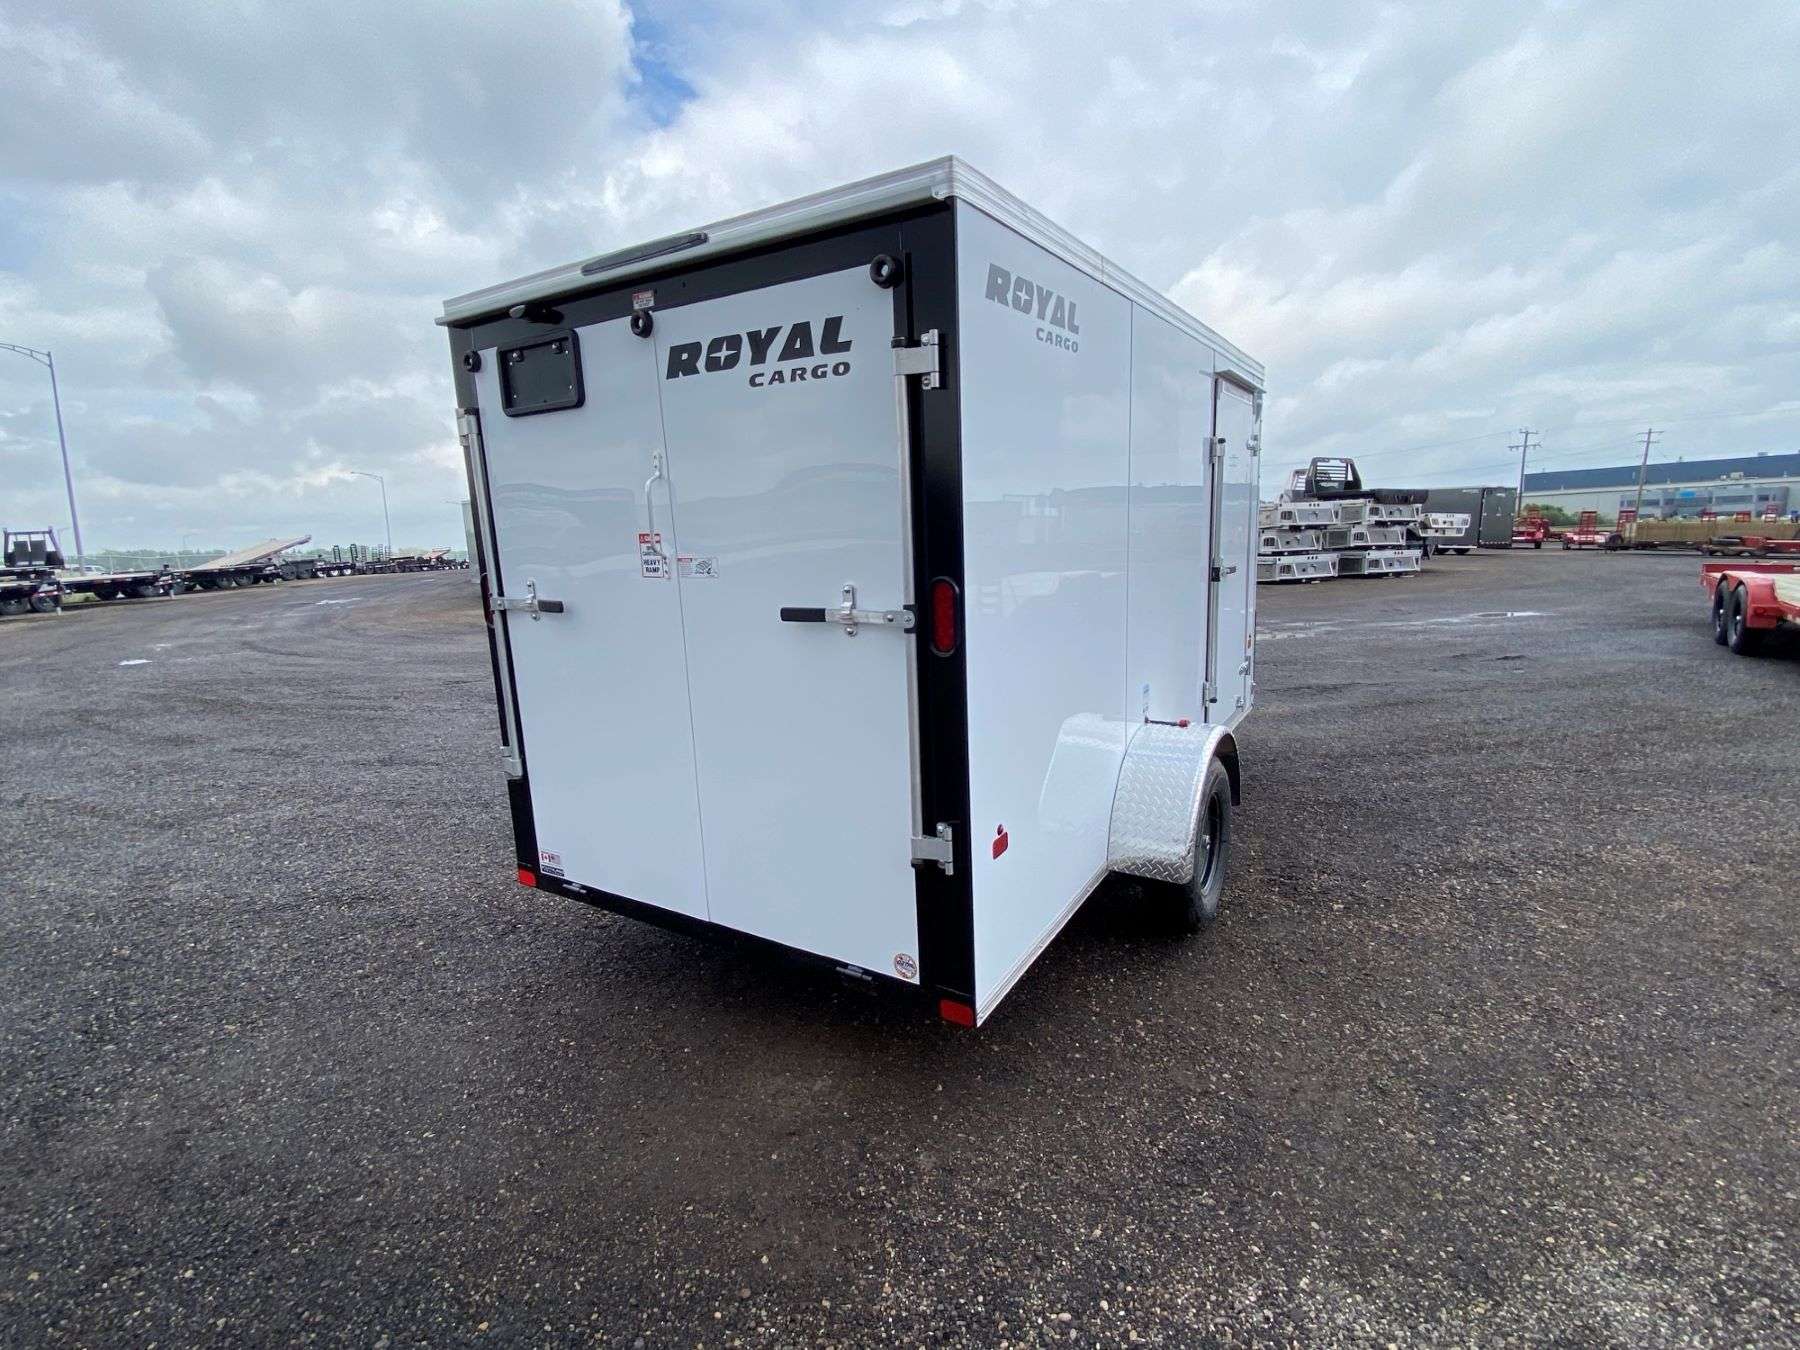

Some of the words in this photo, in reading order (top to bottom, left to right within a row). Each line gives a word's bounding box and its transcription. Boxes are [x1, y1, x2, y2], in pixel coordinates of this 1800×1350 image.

[985, 263, 1079, 335] ROYAL
[666, 315, 852, 380] ROYAL
[1036, 327, 1079, 353] CARGO
[749, 361, 851, 388] CARGO
